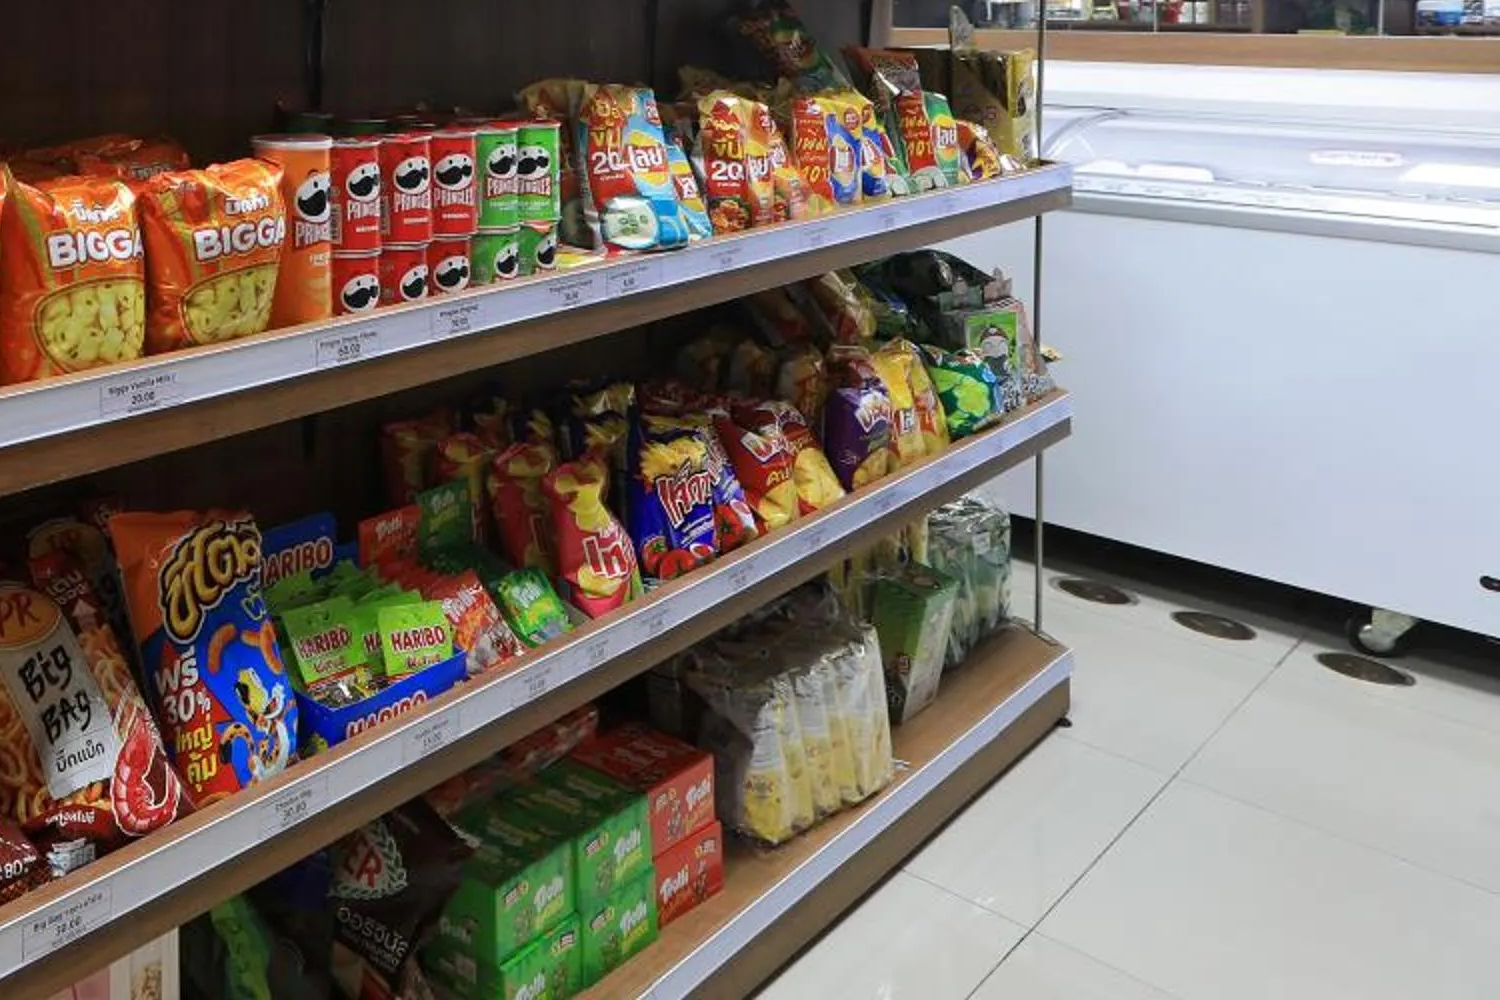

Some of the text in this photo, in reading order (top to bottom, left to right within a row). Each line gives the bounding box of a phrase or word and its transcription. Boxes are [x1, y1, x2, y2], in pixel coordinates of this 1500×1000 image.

[194, 216, 286, 261] BIGGA
[297, 623, 351, 658] HARIBO
[390, 625, 446, 654] HARIBO
[18, 644, 73, 703] Big
[155, 645, 199, 693] ฟรี
[164, 688, 212, 725] 30%
